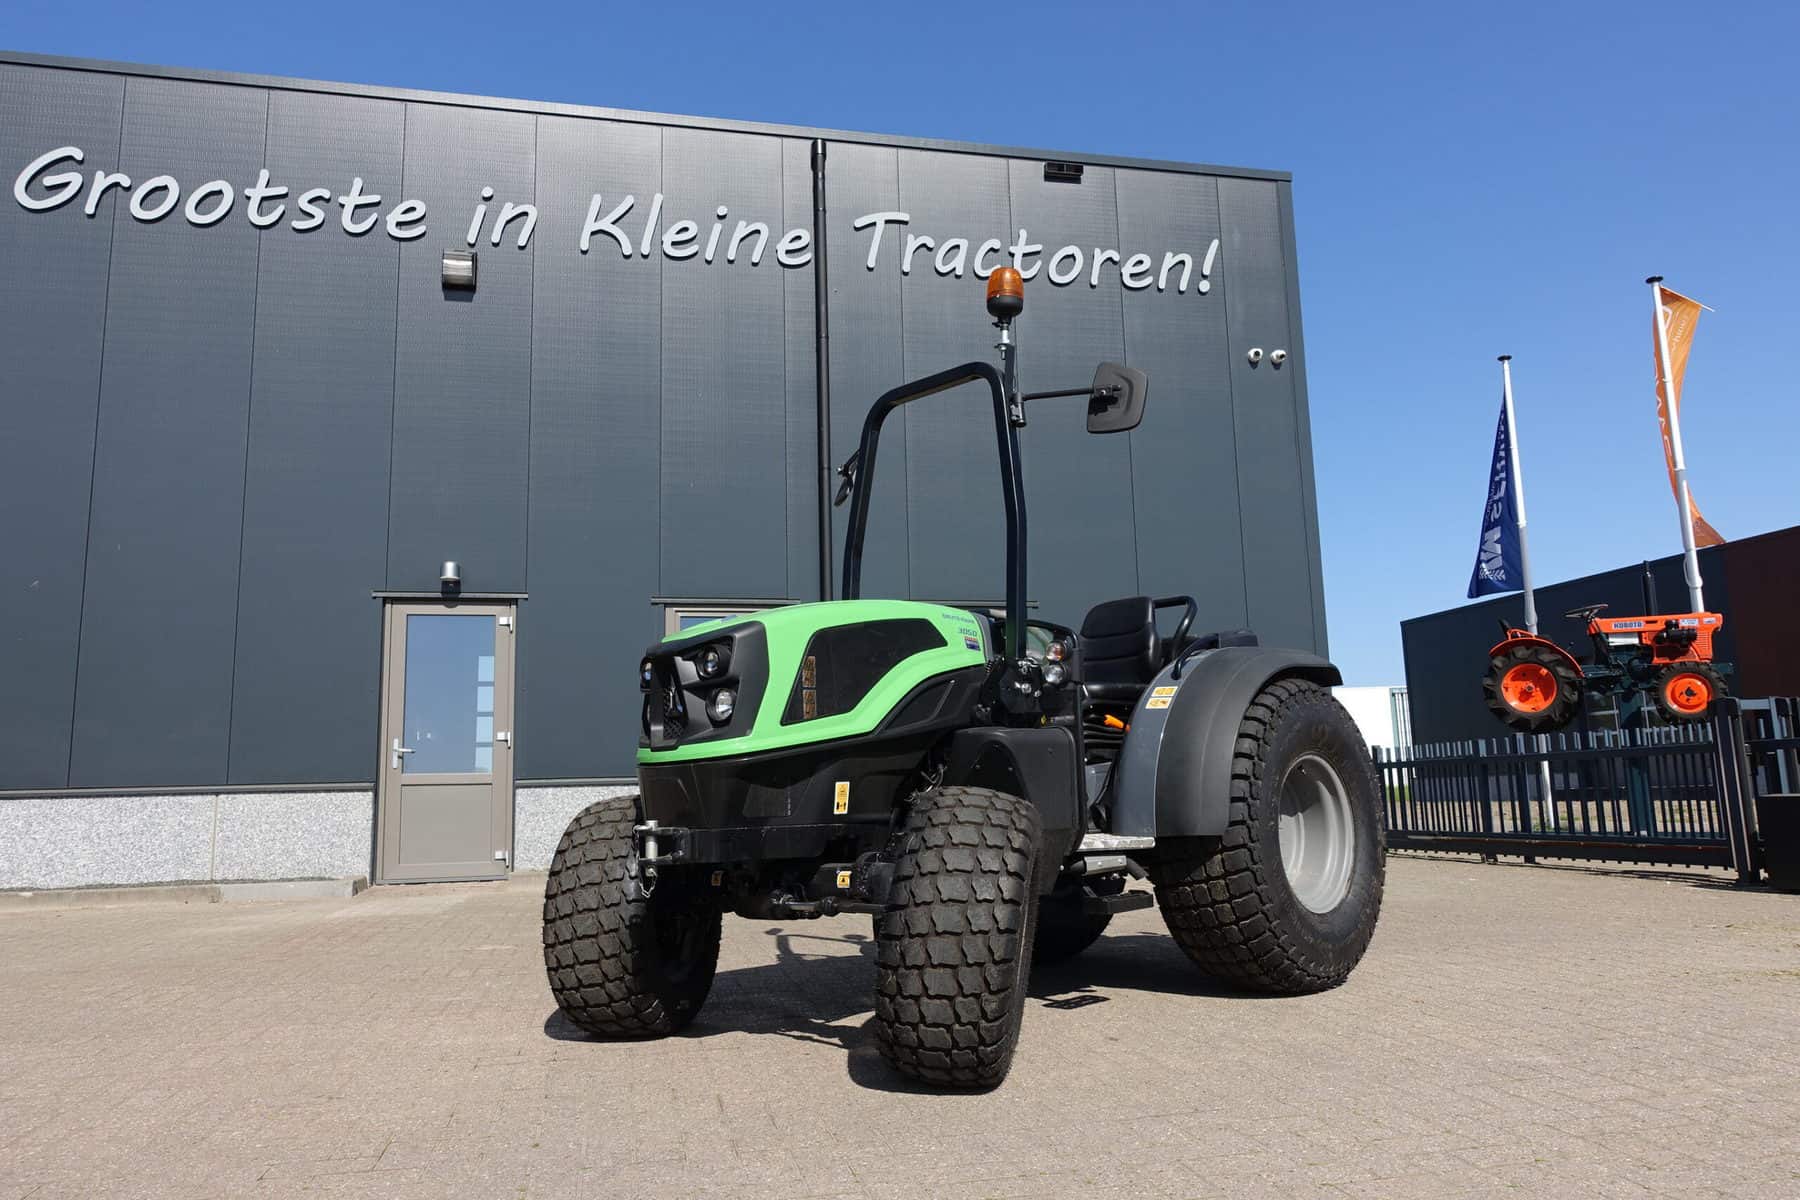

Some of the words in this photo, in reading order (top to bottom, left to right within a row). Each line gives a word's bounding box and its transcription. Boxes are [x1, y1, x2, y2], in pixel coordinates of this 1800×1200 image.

[14, 146, 427, 239] Grootste
[466, 185, 538, 247] in
[579, 192, 813, 266] Kleine
[853, 211, 1220, 293] Tractoren!
